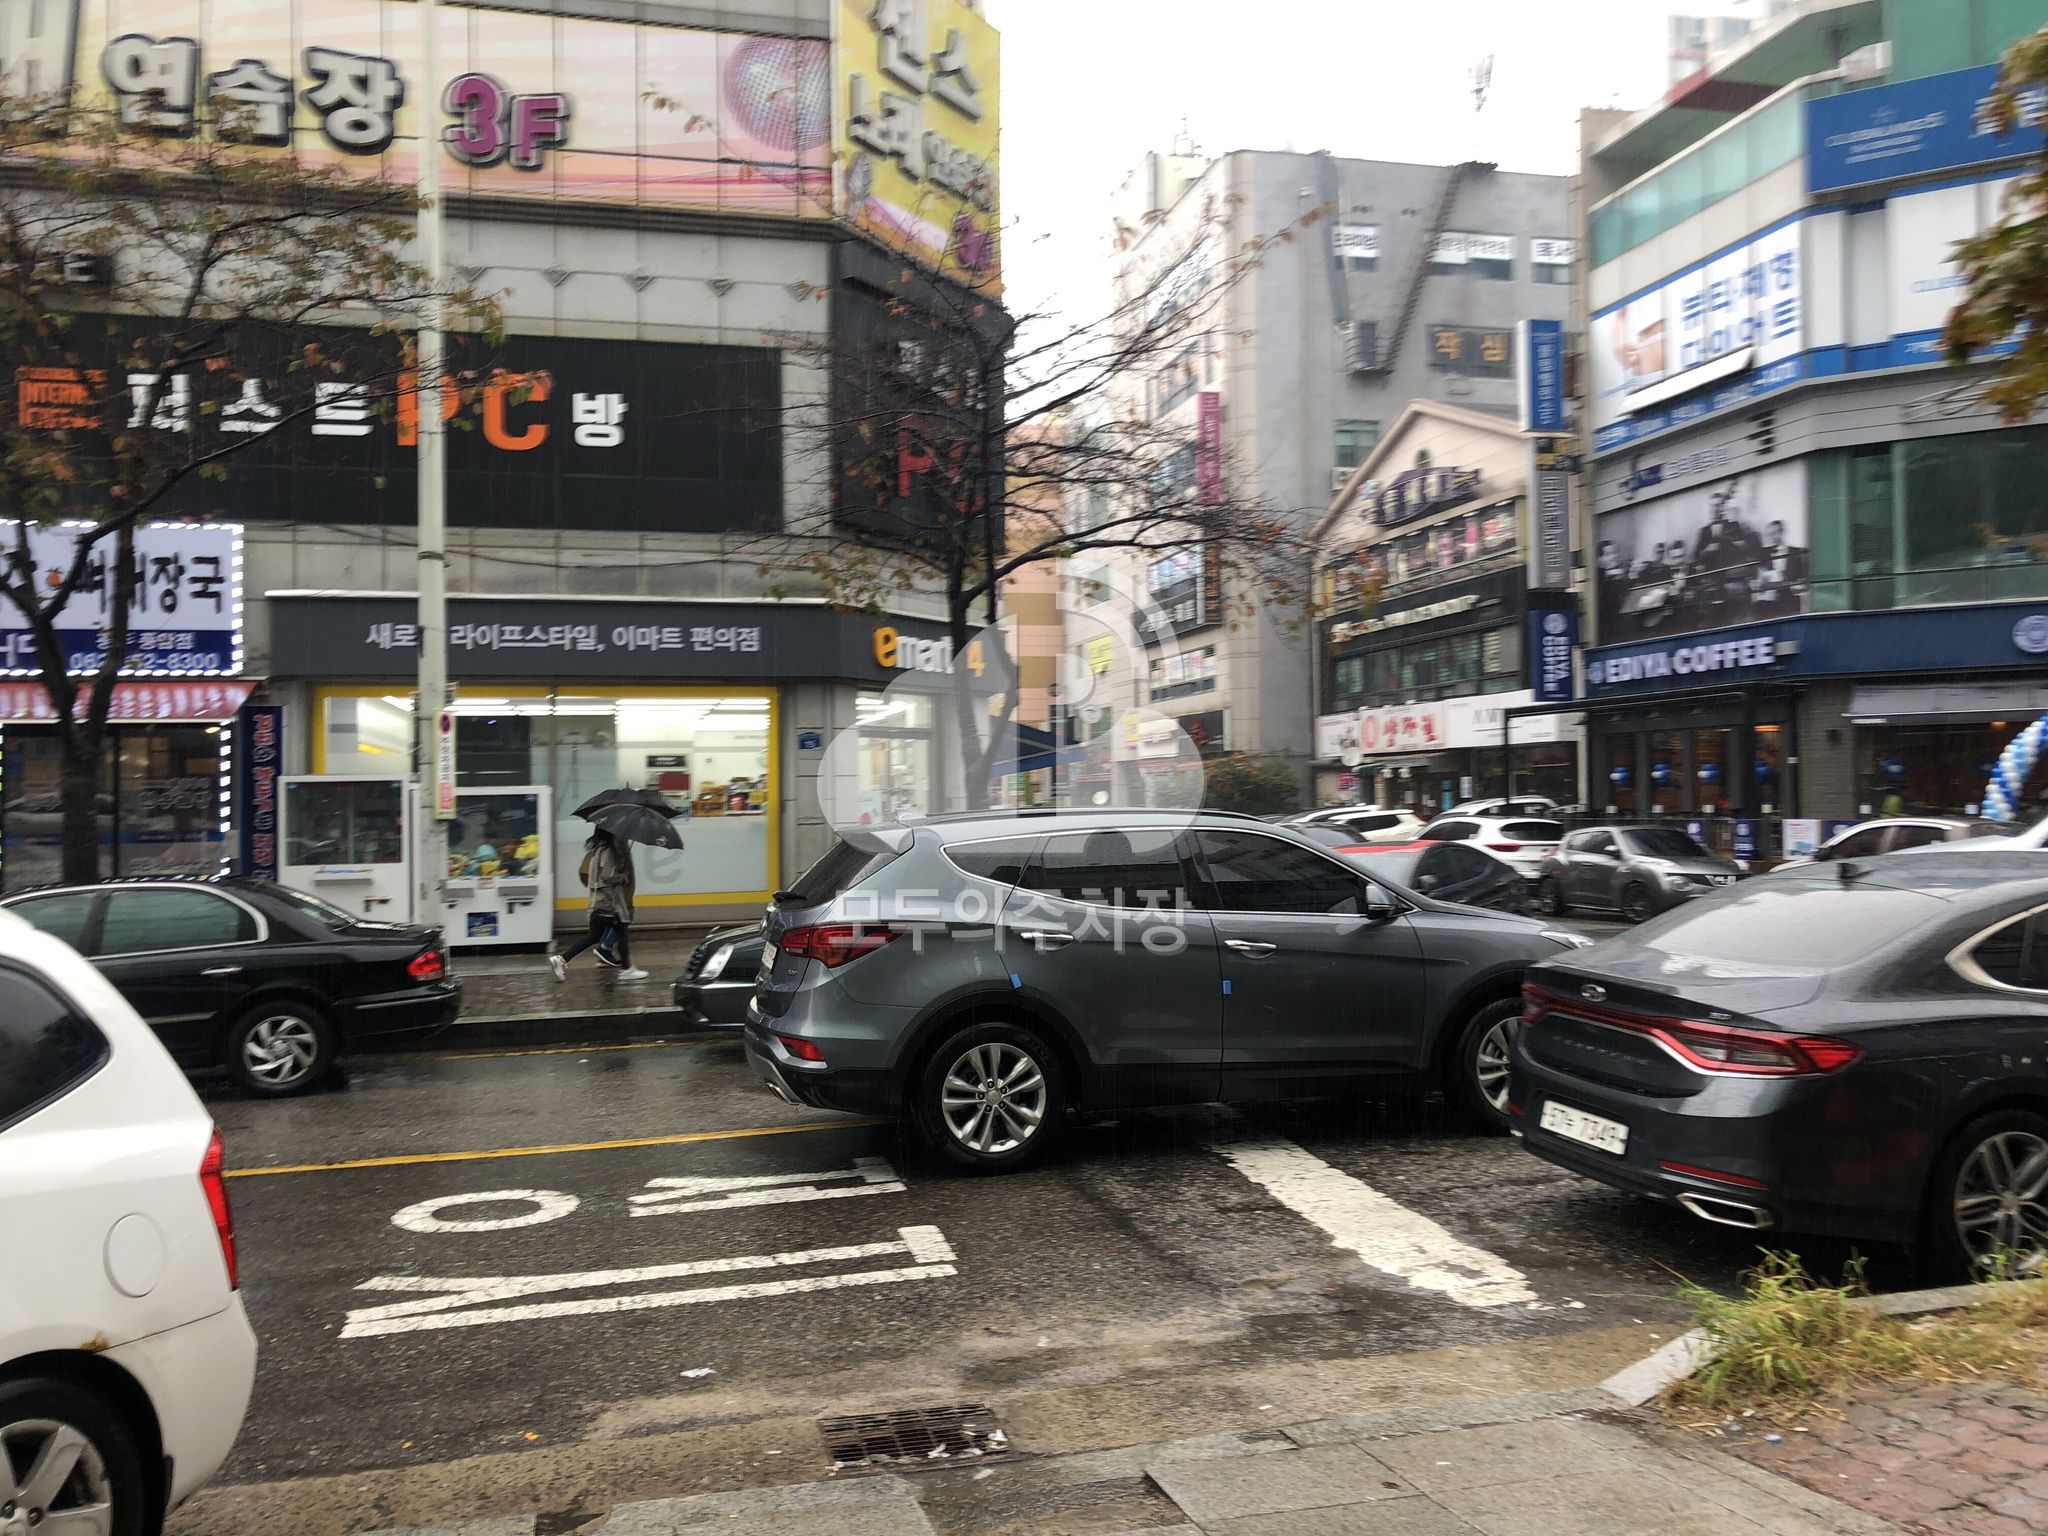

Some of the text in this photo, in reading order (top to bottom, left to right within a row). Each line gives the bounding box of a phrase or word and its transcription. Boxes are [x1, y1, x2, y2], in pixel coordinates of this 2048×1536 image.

[440, 72, 570, 170] 3F
[612, 626, 684, 651] 이마트
[690, 626, 761, 652] 편의점
[1605, 636, 1776, 684] EDIYA COFFEE
